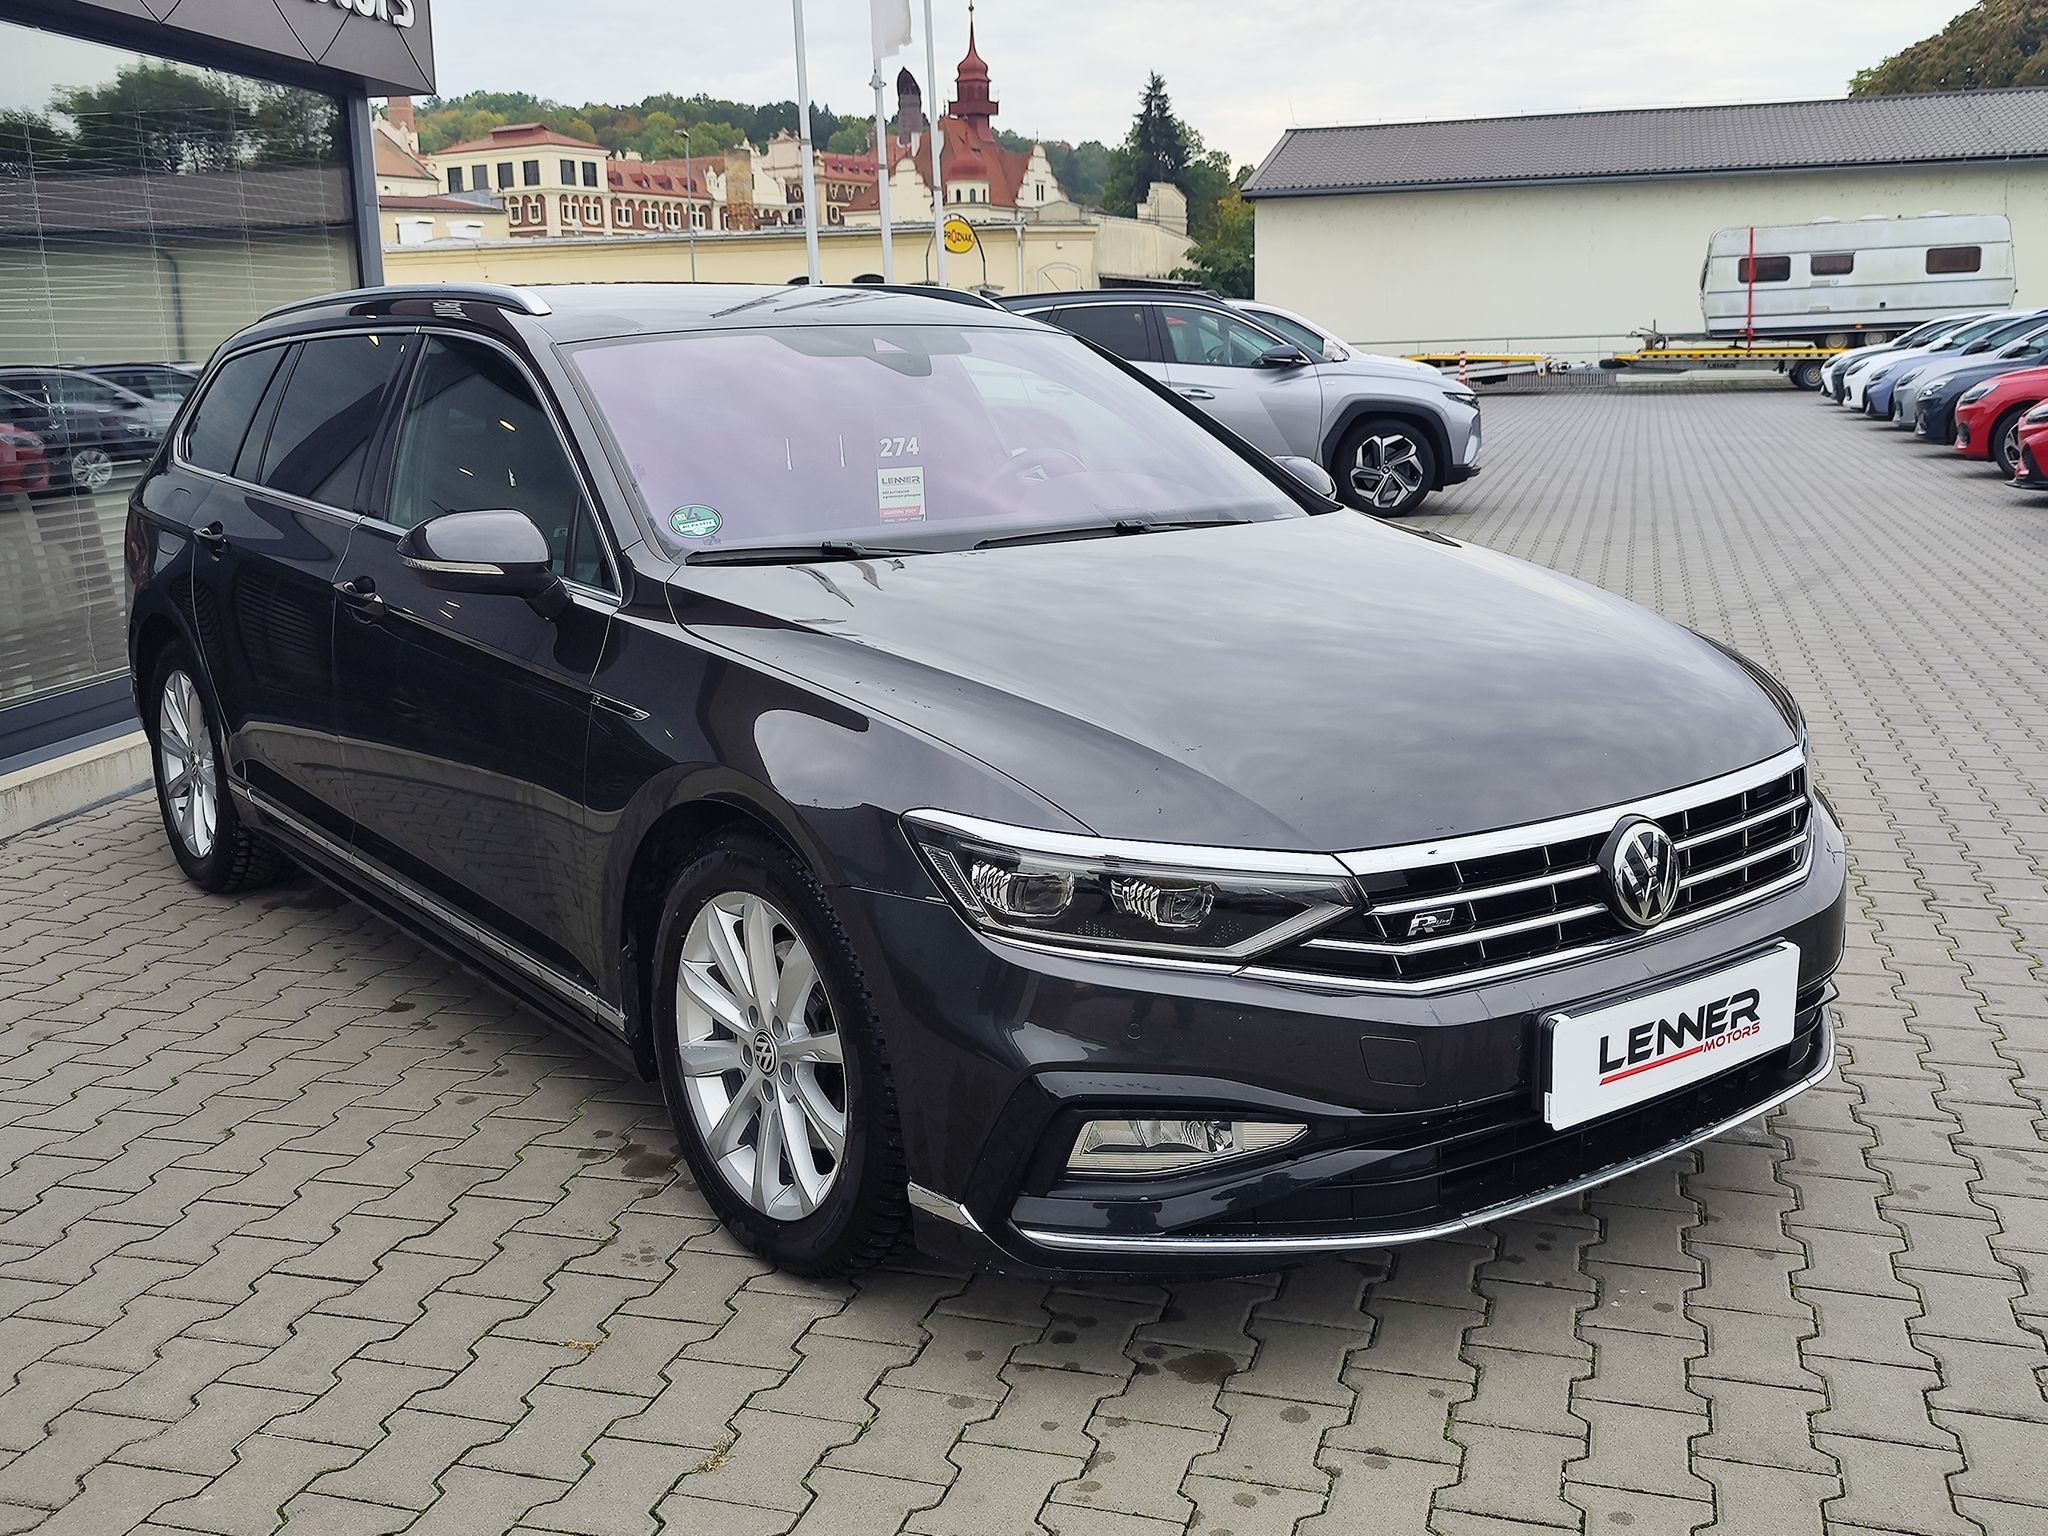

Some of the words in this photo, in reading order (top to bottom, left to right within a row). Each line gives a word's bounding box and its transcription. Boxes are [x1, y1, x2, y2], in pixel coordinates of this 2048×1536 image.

[880, 437, 920, 457] 274
[1599, 988, 1761, 1075] LENNER
[1703, 1021, 1761, 1053] MOTORS
